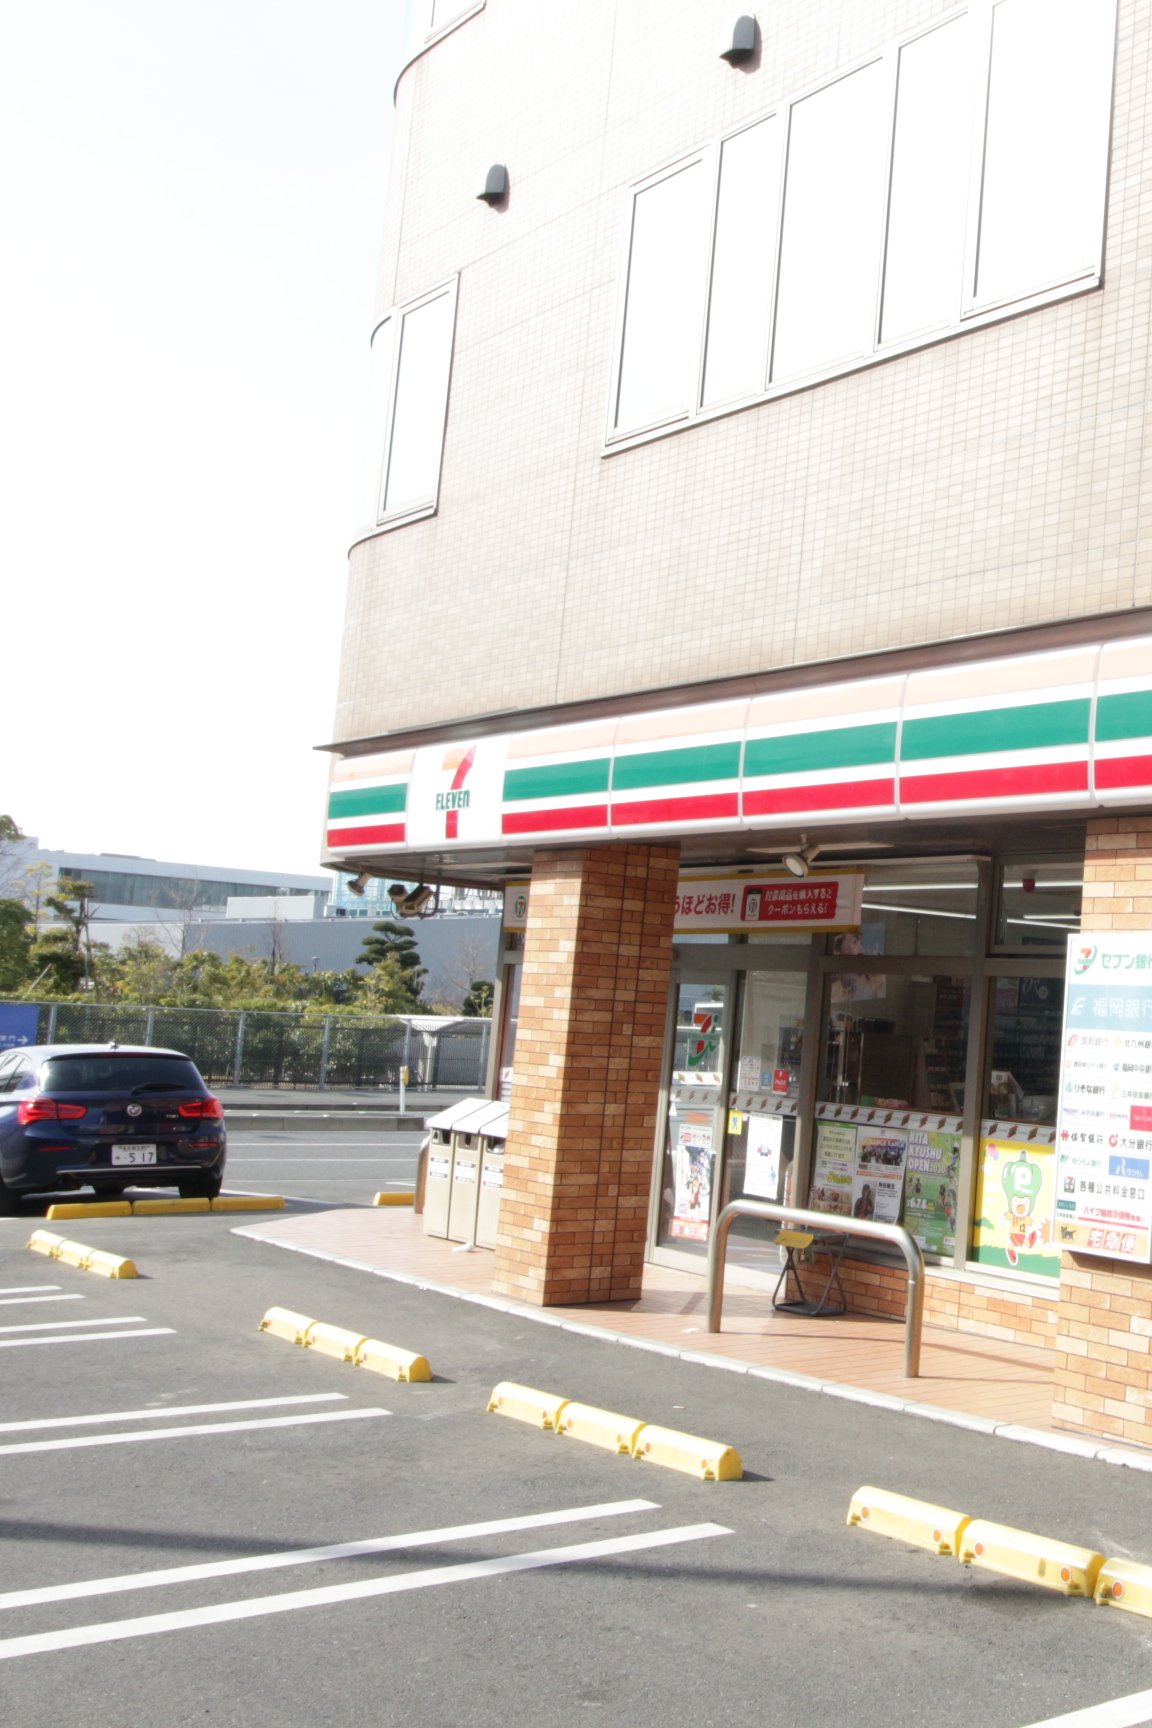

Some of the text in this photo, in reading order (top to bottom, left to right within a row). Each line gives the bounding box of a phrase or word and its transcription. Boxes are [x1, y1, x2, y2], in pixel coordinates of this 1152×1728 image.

[1074, 1084, 1106, 1096] りそな銀行
[908, 1144, 942, 1160] KYUSHU
[1120, 1138, 1152, 1151] 大分銀行
[908, 1159, 930, 1173] OPEN
[1079, 1180, 1146, 1200] 各種公共料金窓口
[1088, 1228, 1136, 1254] 宅急便
